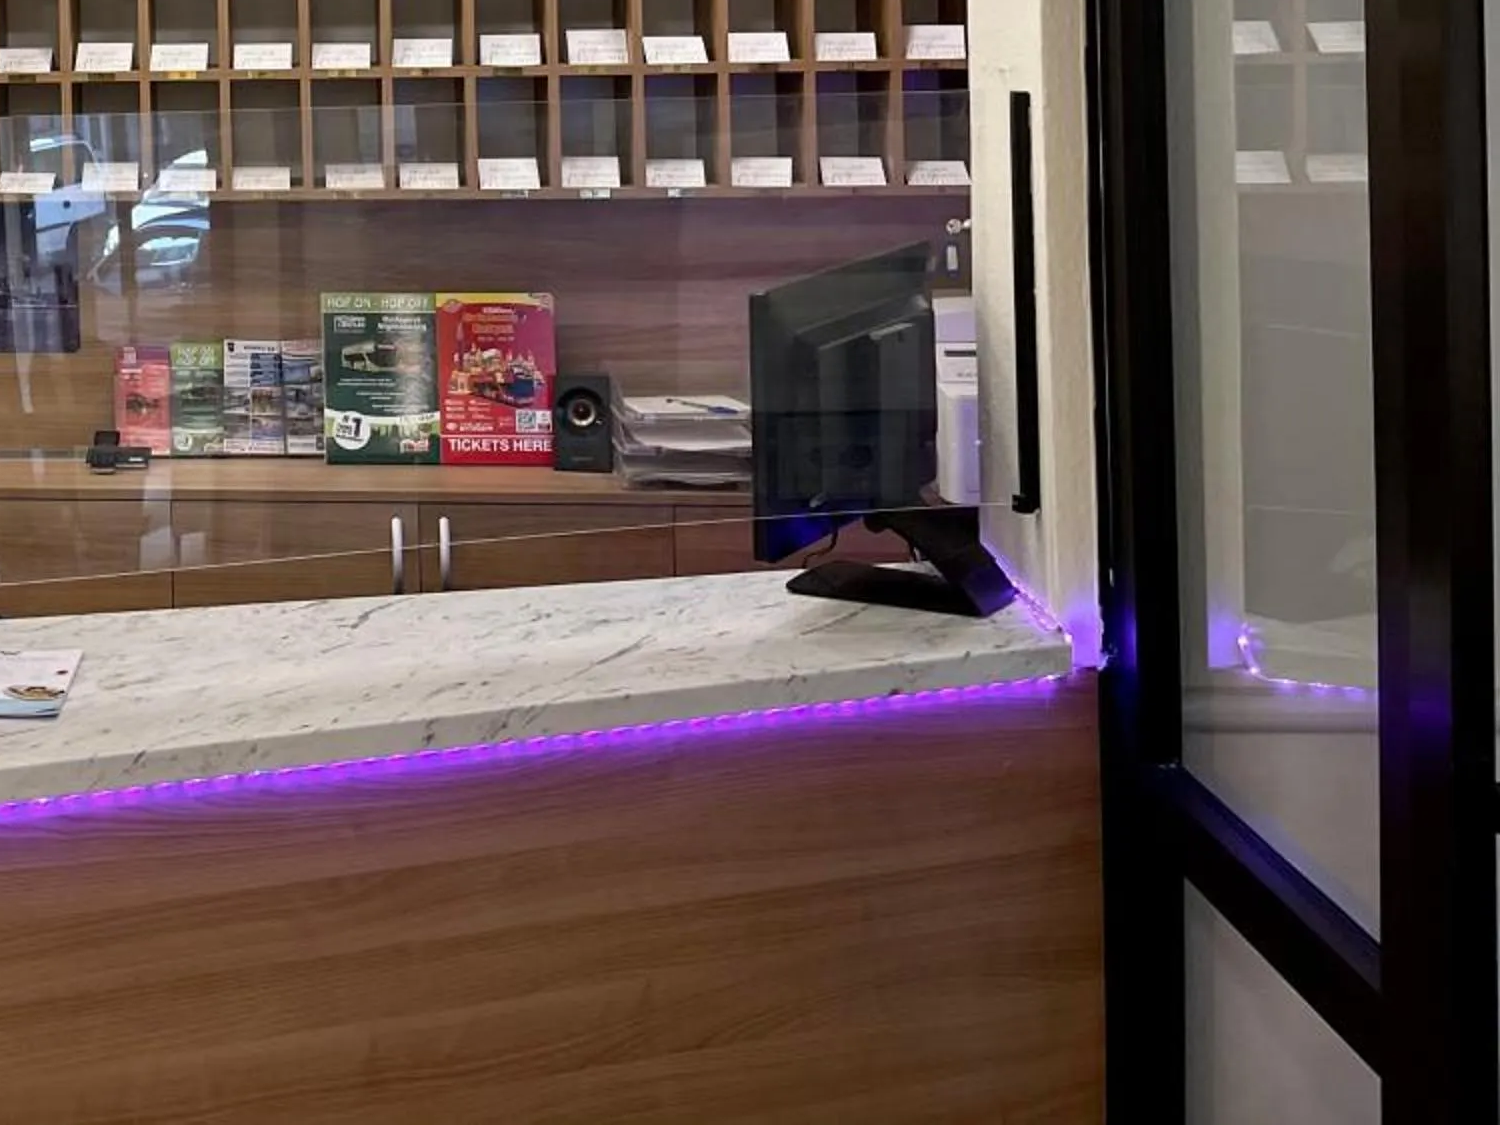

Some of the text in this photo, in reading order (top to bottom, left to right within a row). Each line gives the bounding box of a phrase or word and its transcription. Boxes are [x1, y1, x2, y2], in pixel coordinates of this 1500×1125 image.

[381, 298, 405, 308] HOP
[447, 438, 553, 452] TICKETS HERE
